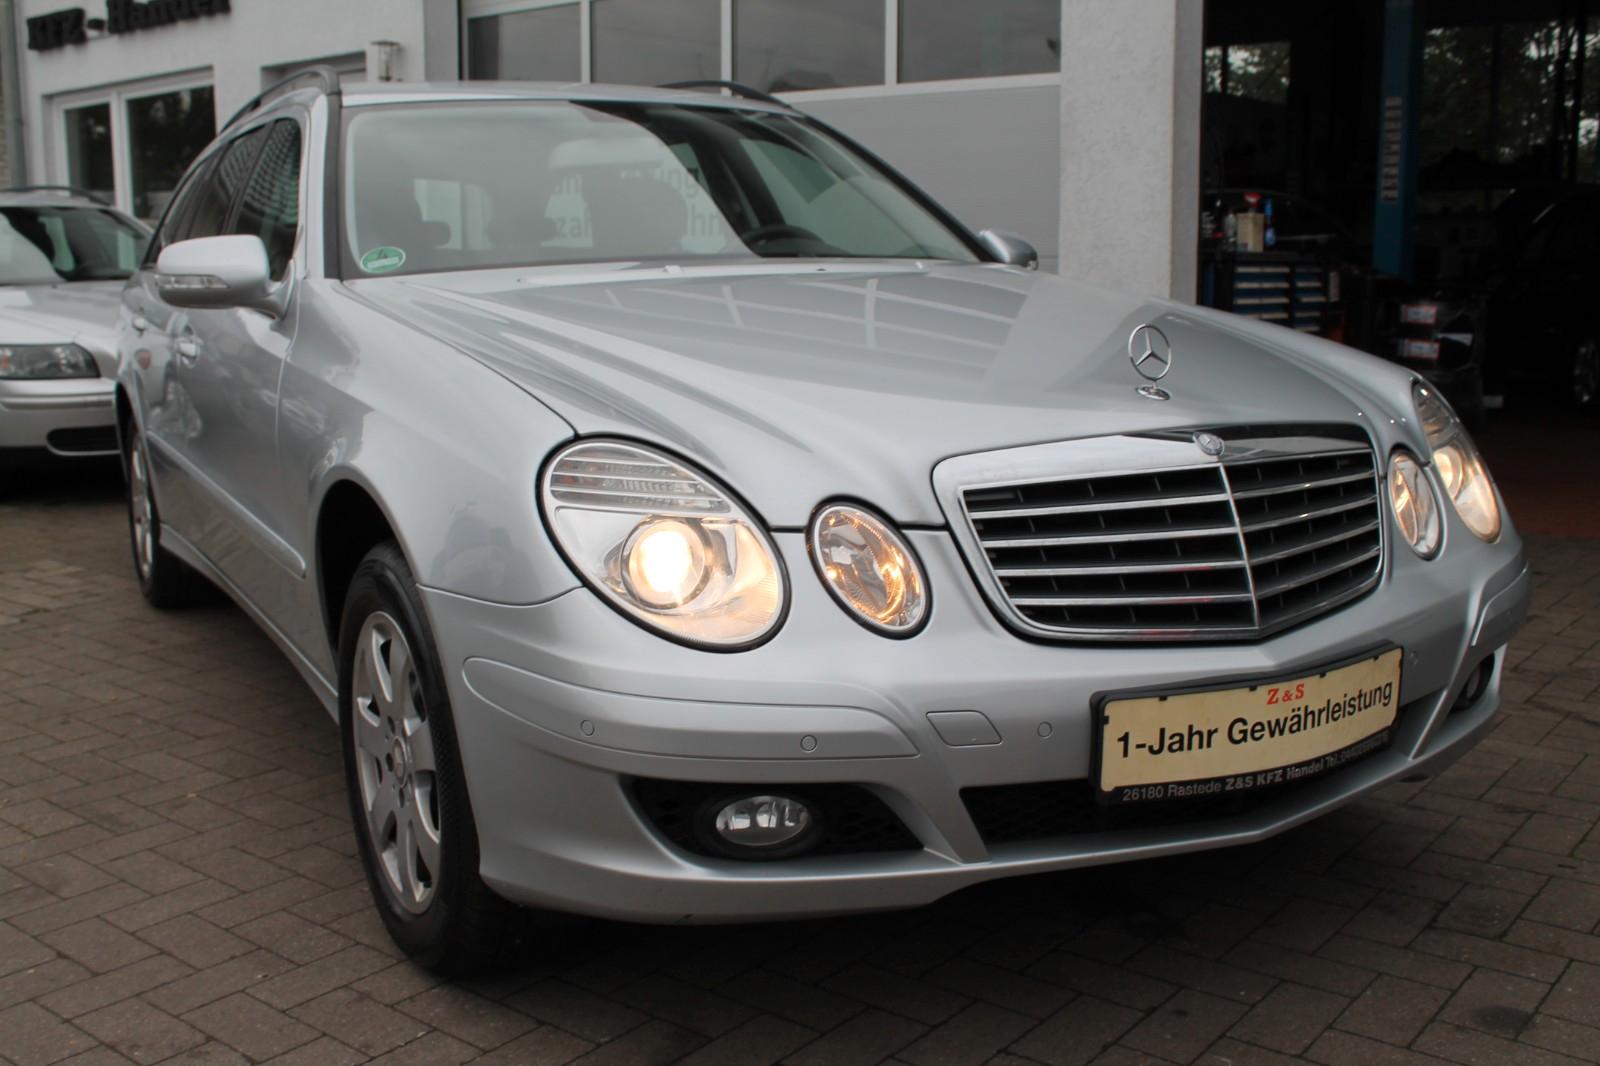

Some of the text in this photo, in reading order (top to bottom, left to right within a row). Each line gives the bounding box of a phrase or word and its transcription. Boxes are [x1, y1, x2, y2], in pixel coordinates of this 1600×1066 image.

[1117, 681, 1393, 758] 1-Jahr Gewährleistung
[1122, 786, 1164, 801] 26180
[1167, 781, 1221, 797] Rastede
[1225, 776, 1254, 791] Z&S
[1257, 769, 1283, 786] KFZ
[1286, 759, 1324, 780] Handel
